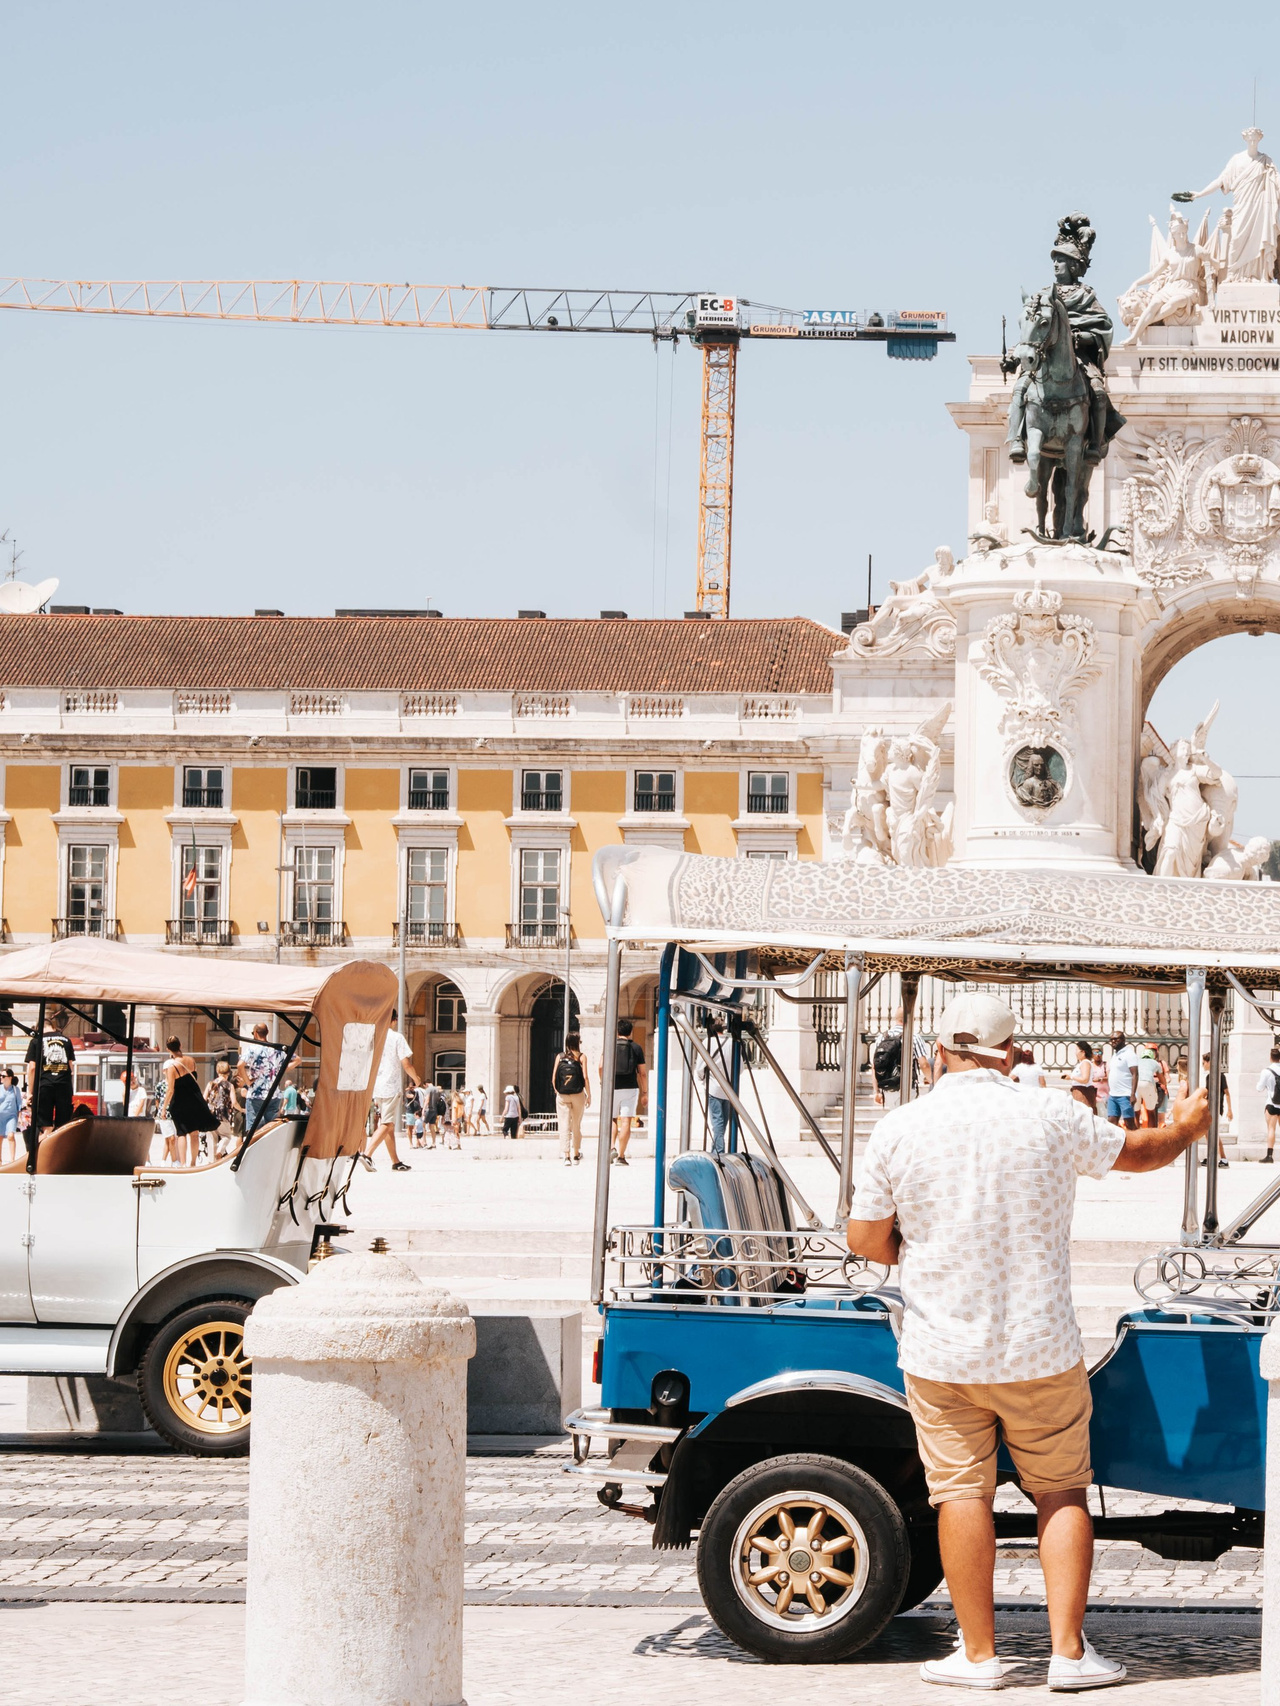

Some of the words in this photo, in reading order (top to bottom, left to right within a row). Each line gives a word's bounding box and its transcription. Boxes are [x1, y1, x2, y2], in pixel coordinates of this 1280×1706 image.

[700, 299, 734, 311] EC-B
[1220, 330, 1275, 343] MAIORVM
[564, 1074, 573, 1086] 7
